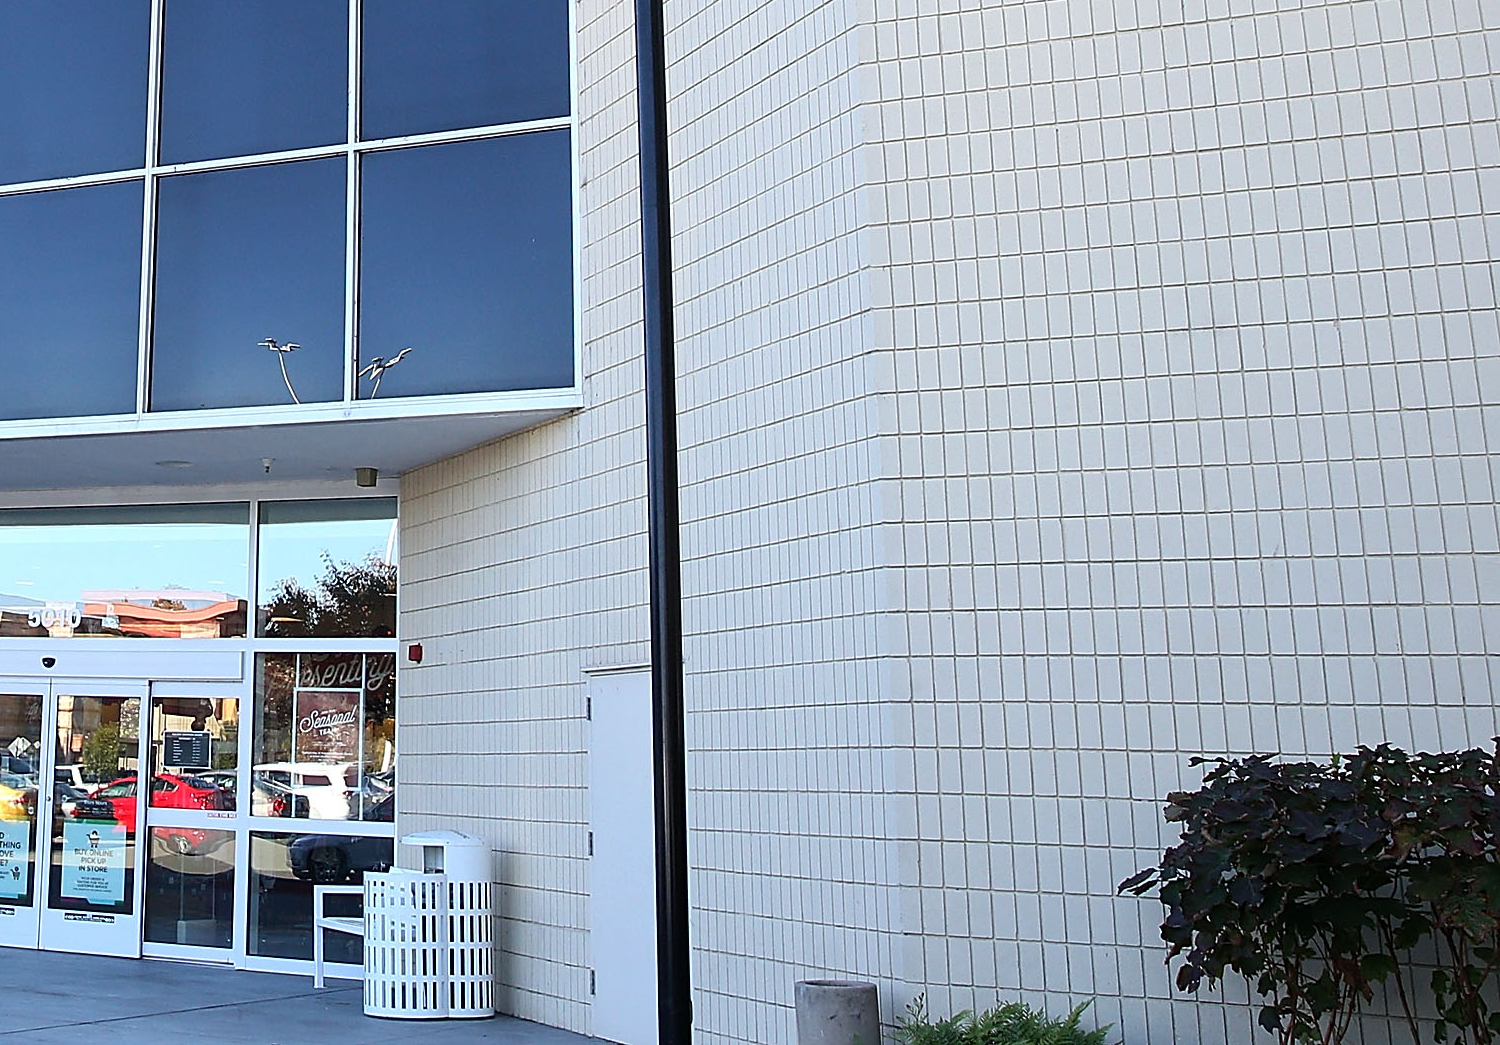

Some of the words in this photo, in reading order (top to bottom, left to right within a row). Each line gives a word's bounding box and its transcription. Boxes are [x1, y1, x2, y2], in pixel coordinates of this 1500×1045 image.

[27, 608, 82, 629] 5010
[299, 704, 358, 733] Seasonal
[74, 848, 88, 856] BUY
[88, 849, 114, 858] ONLINE
[80, 856, 96, 864] PICK
[97, 857, 106, 865] UP
[86, 865, 108, 873] STORE
